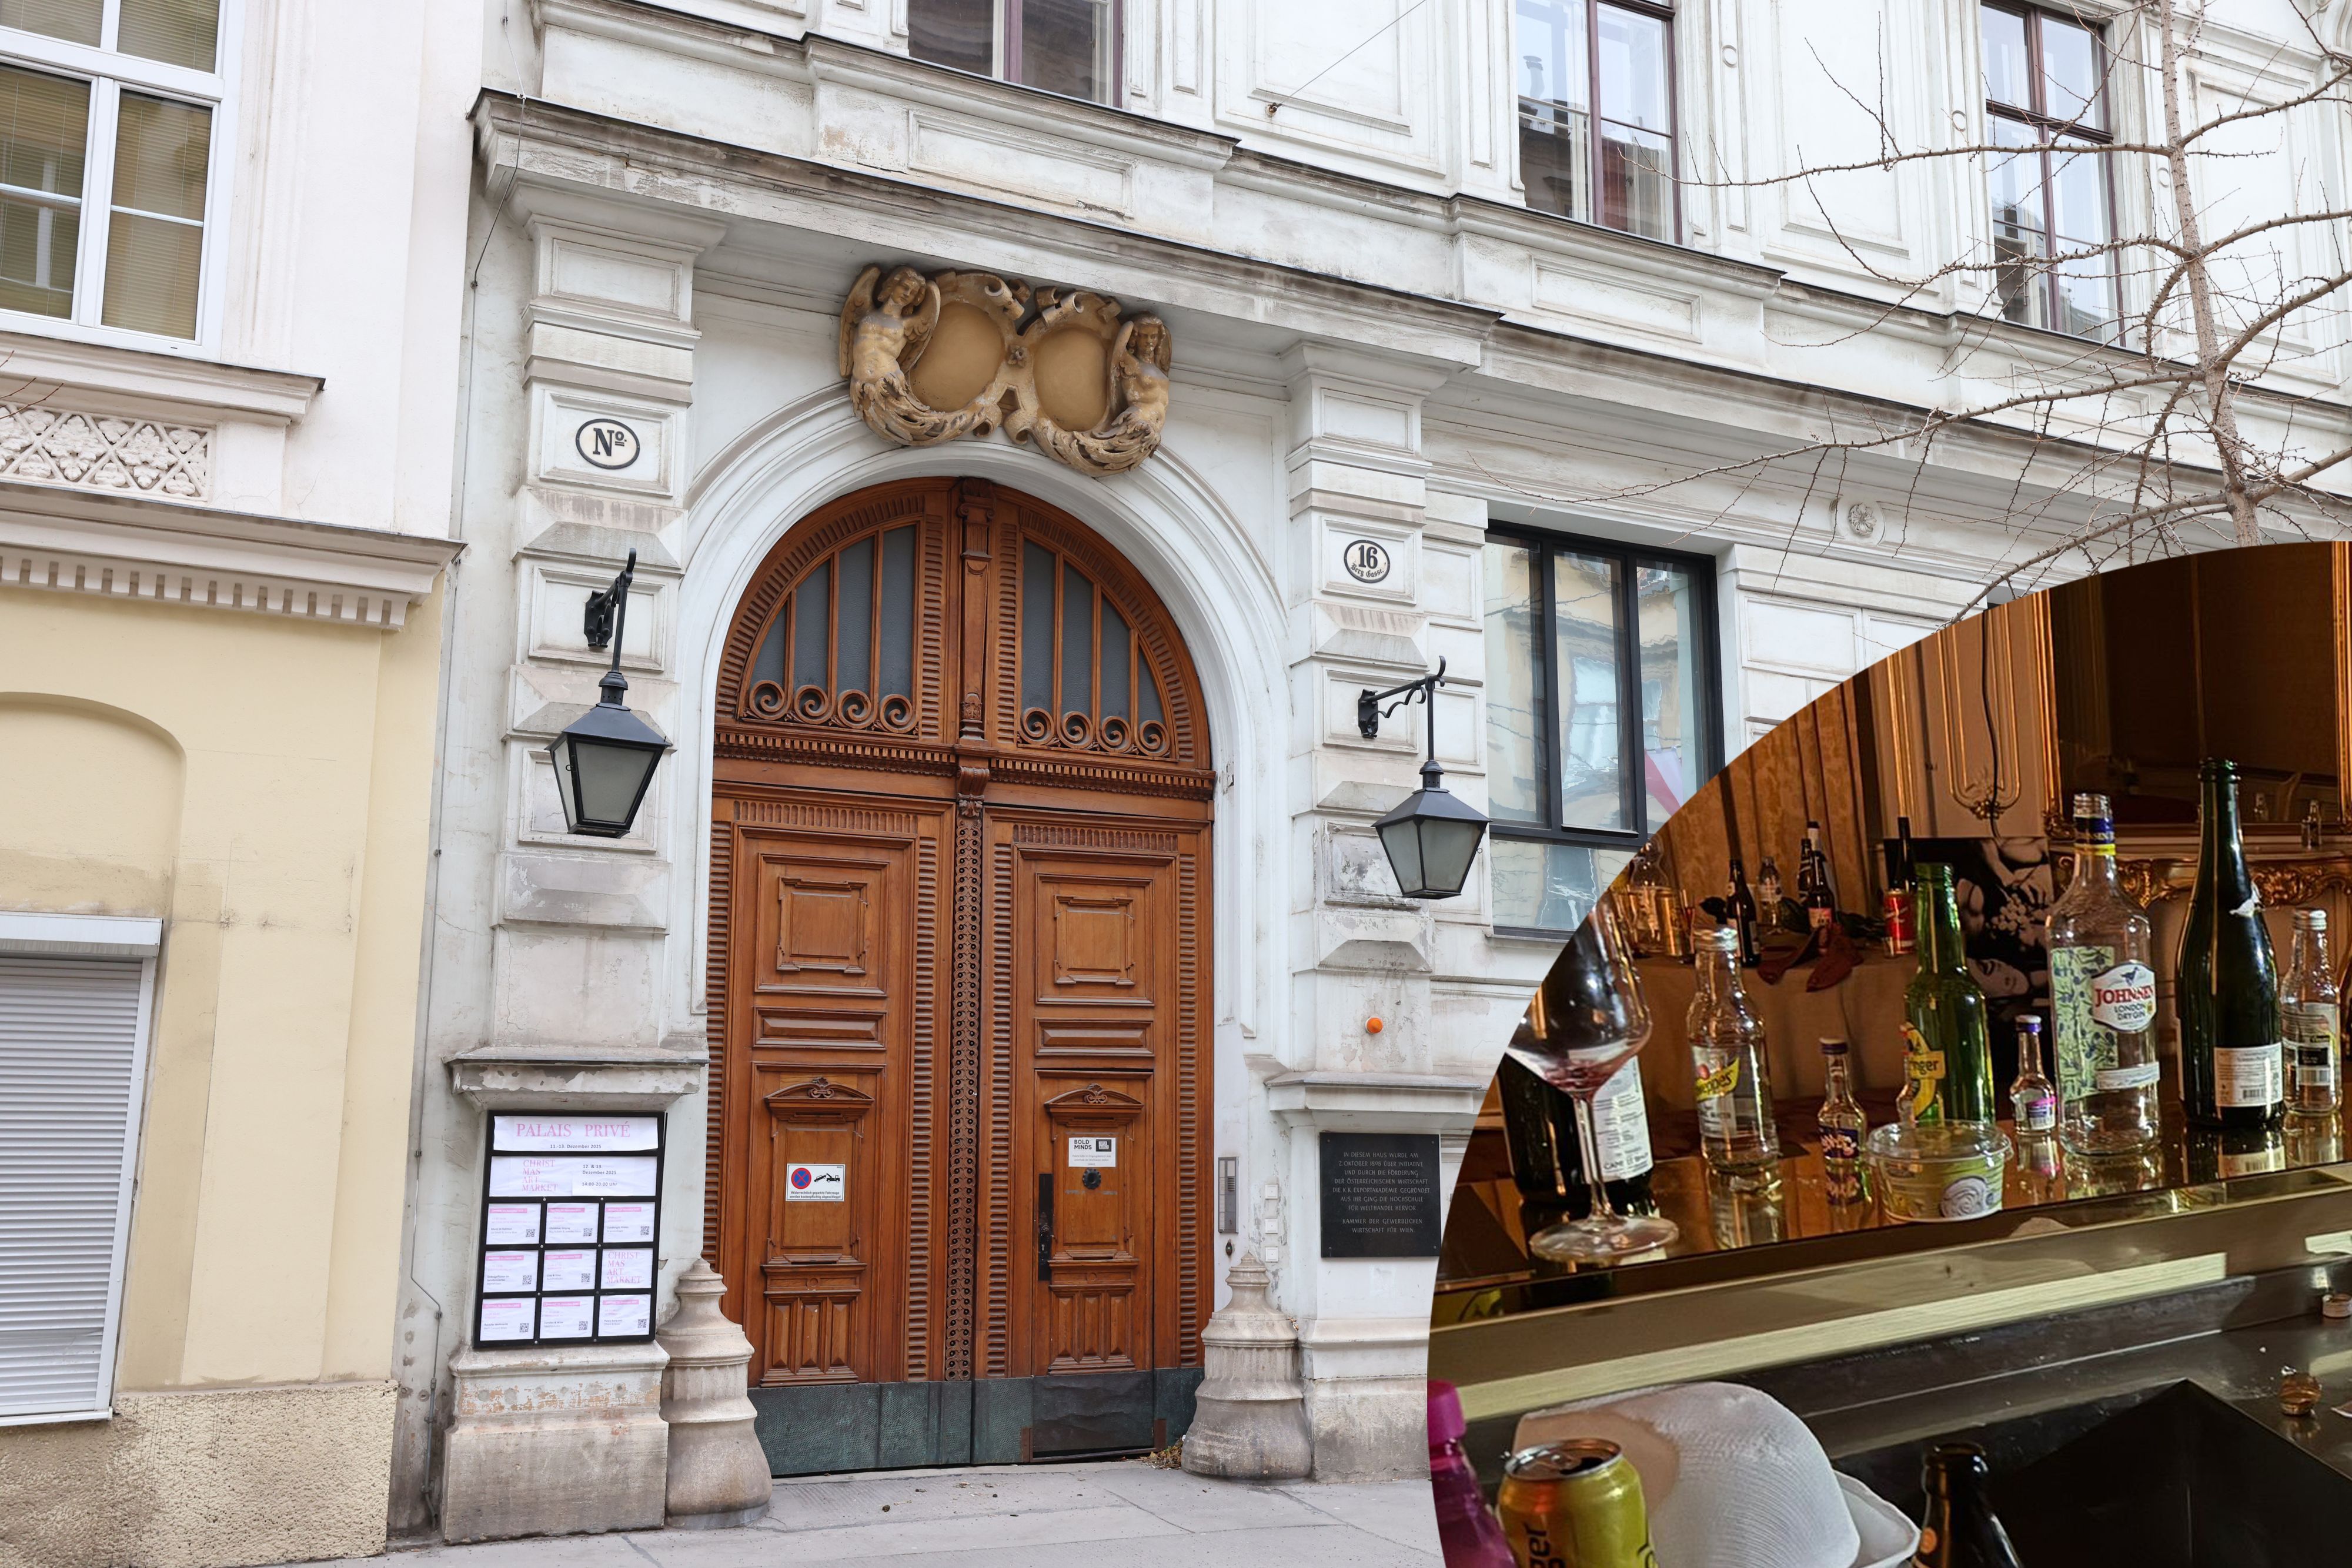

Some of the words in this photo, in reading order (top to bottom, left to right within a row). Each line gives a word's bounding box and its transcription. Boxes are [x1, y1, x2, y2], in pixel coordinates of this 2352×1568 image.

[1358, 544, 1378, 569] 16
[2114, 1003, 2146, 1013] LONDON
[516, 1124, 572, 1138] PALAIS
[584, 1121, 630, 1138] PRIVÉ
[1388, 1169, 1418, 1178] FÖRDERUNG
